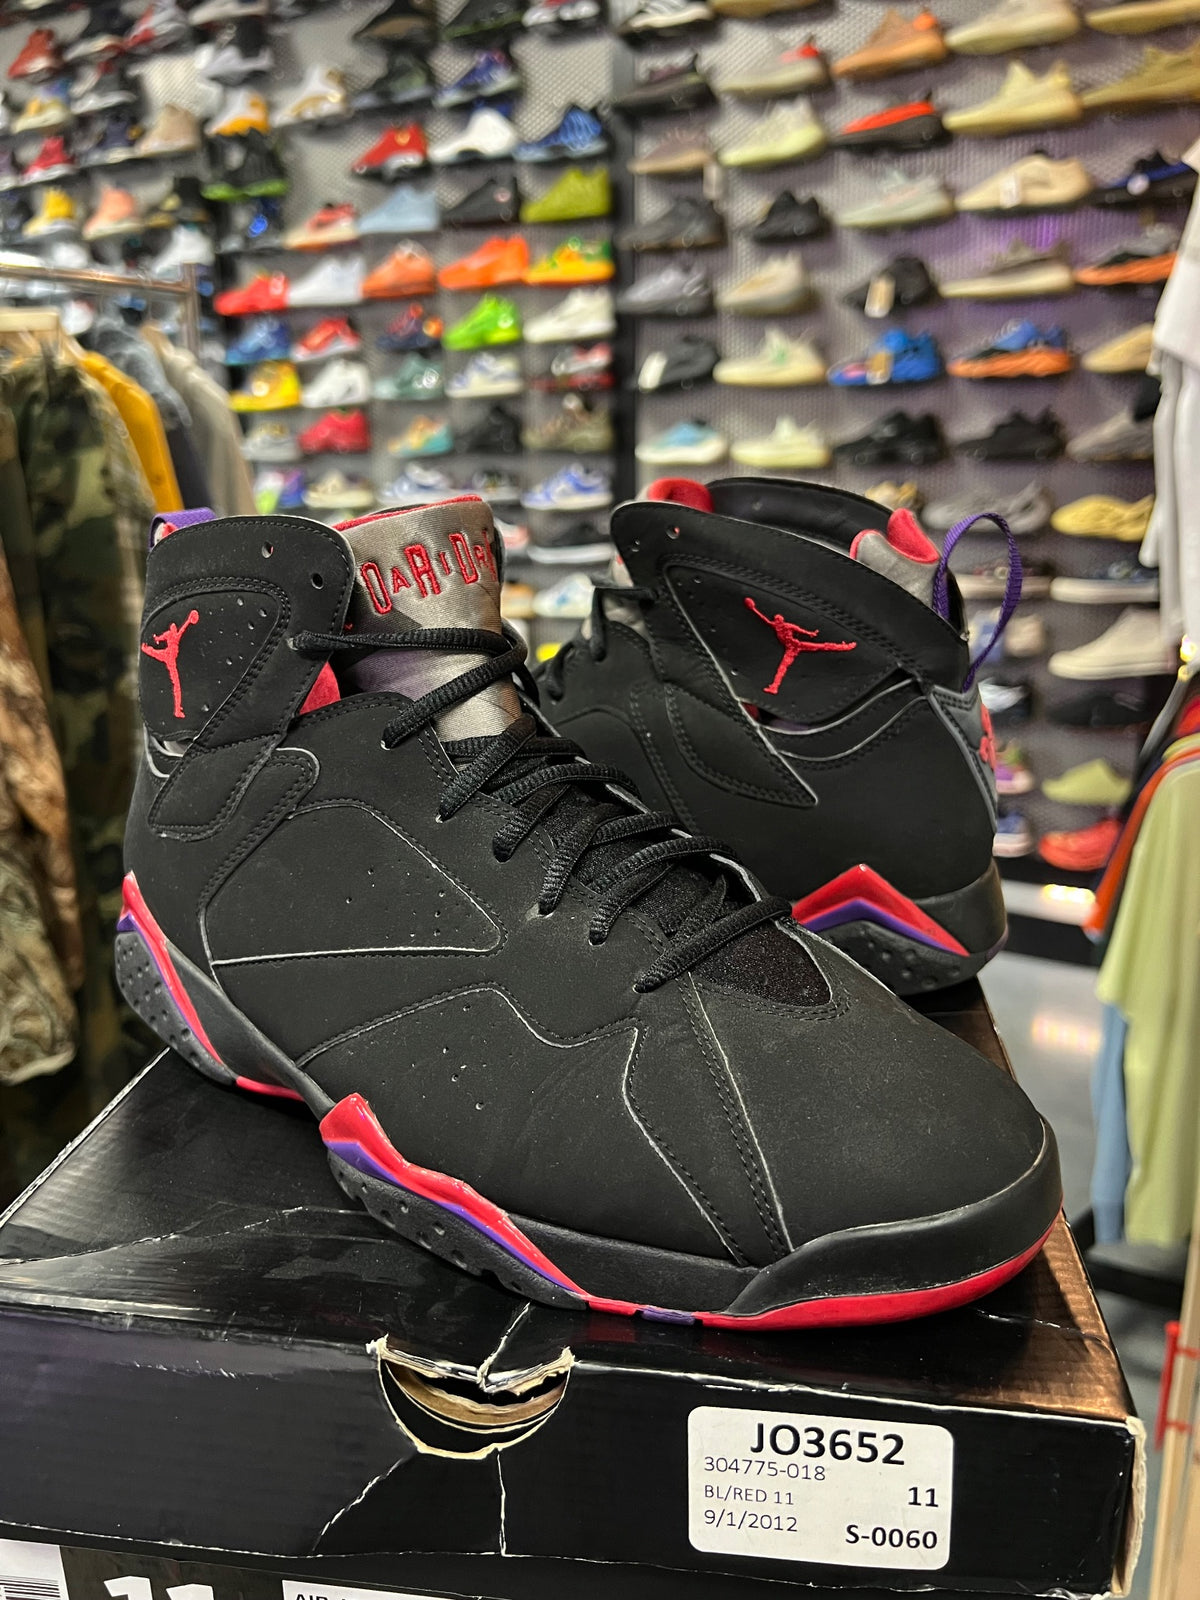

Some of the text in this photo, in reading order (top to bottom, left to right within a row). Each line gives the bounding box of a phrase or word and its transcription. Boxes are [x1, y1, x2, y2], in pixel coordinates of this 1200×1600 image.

[750, 1422, 905, 1466] JO3652
[703, 1456, 826, 1481] 304775-018
[704, 1485, 795, 1506] BL/RED 11
[908, 1486, 940, 1508] 11
[703, 1509, 798, 1533] 9/1/2012
[845, 1524, 939, 1550] S-0060
